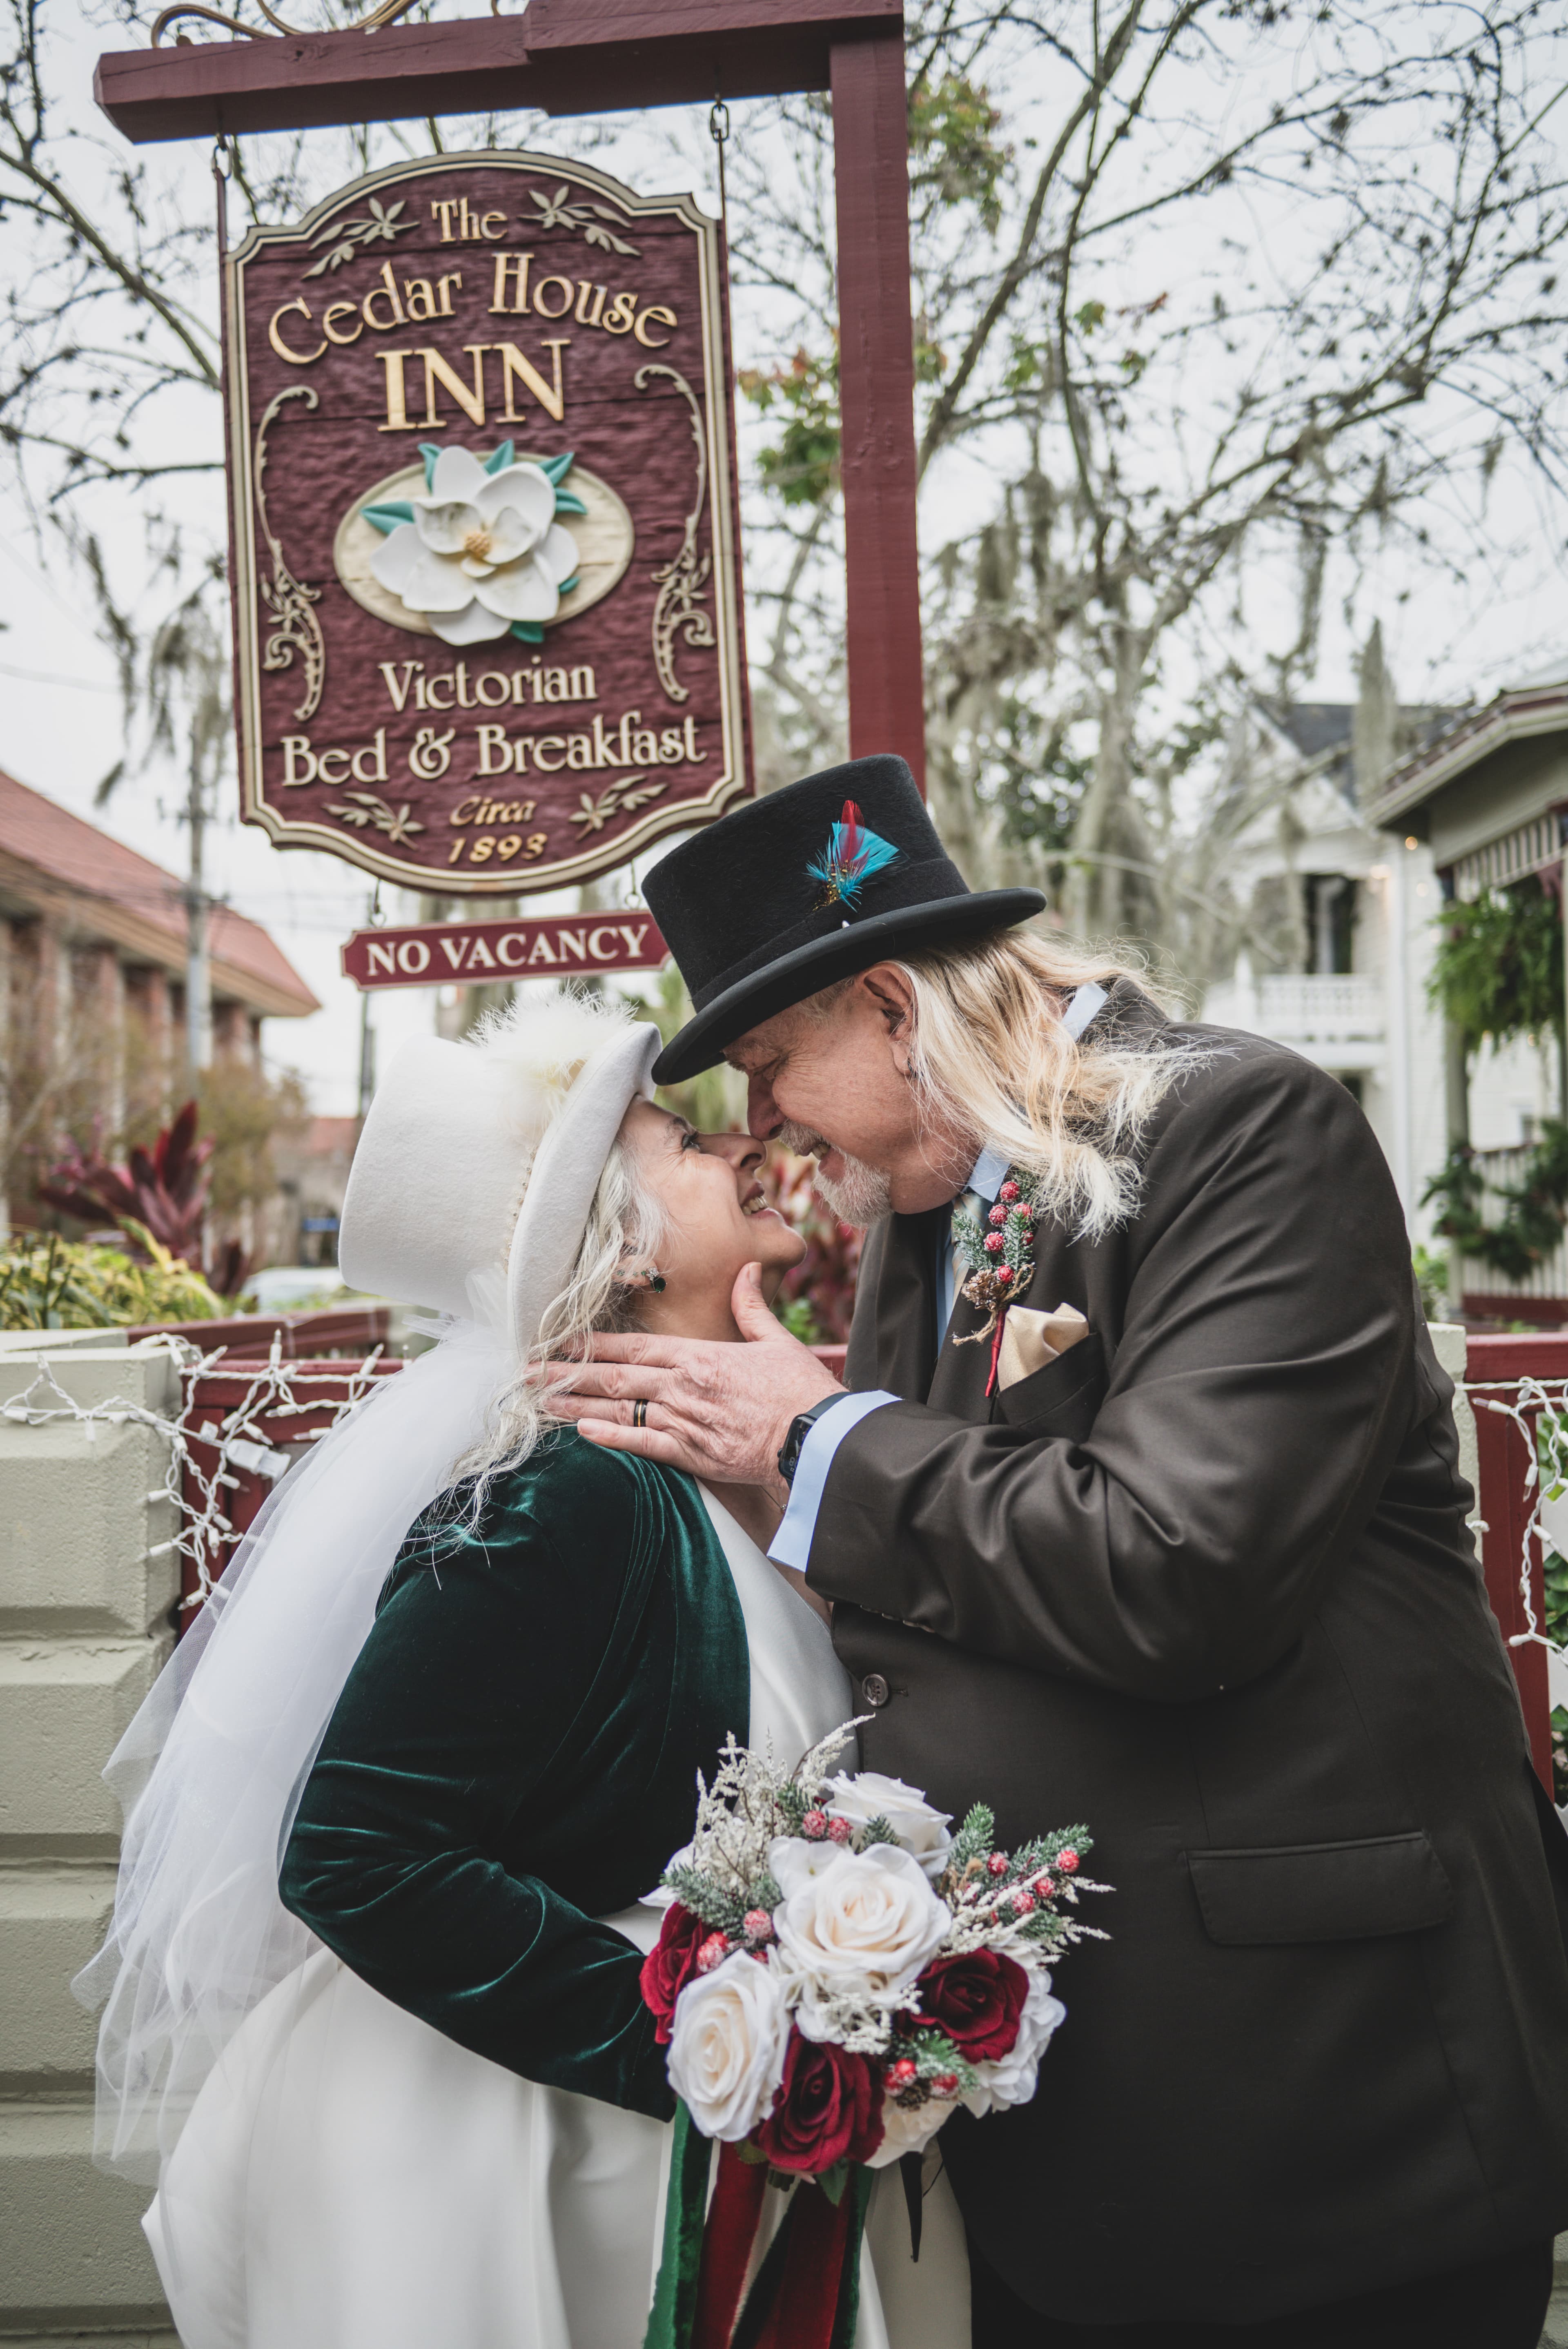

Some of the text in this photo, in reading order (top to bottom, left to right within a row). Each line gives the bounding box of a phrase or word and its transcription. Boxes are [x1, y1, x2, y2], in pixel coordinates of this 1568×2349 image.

[431, 196, 508, 243] The
[268, 252, 678, 364] Cedar House
[374, 339, 572, 432] INN
[378, 655, 598, 712] Victorian
[280, 710, 708, 787] Bed & Breakfast
[449, 795, 537, 826] Circa
[448, 832, 548, 864] 1893
[366, 924, 649, 976] NO VACANCY
